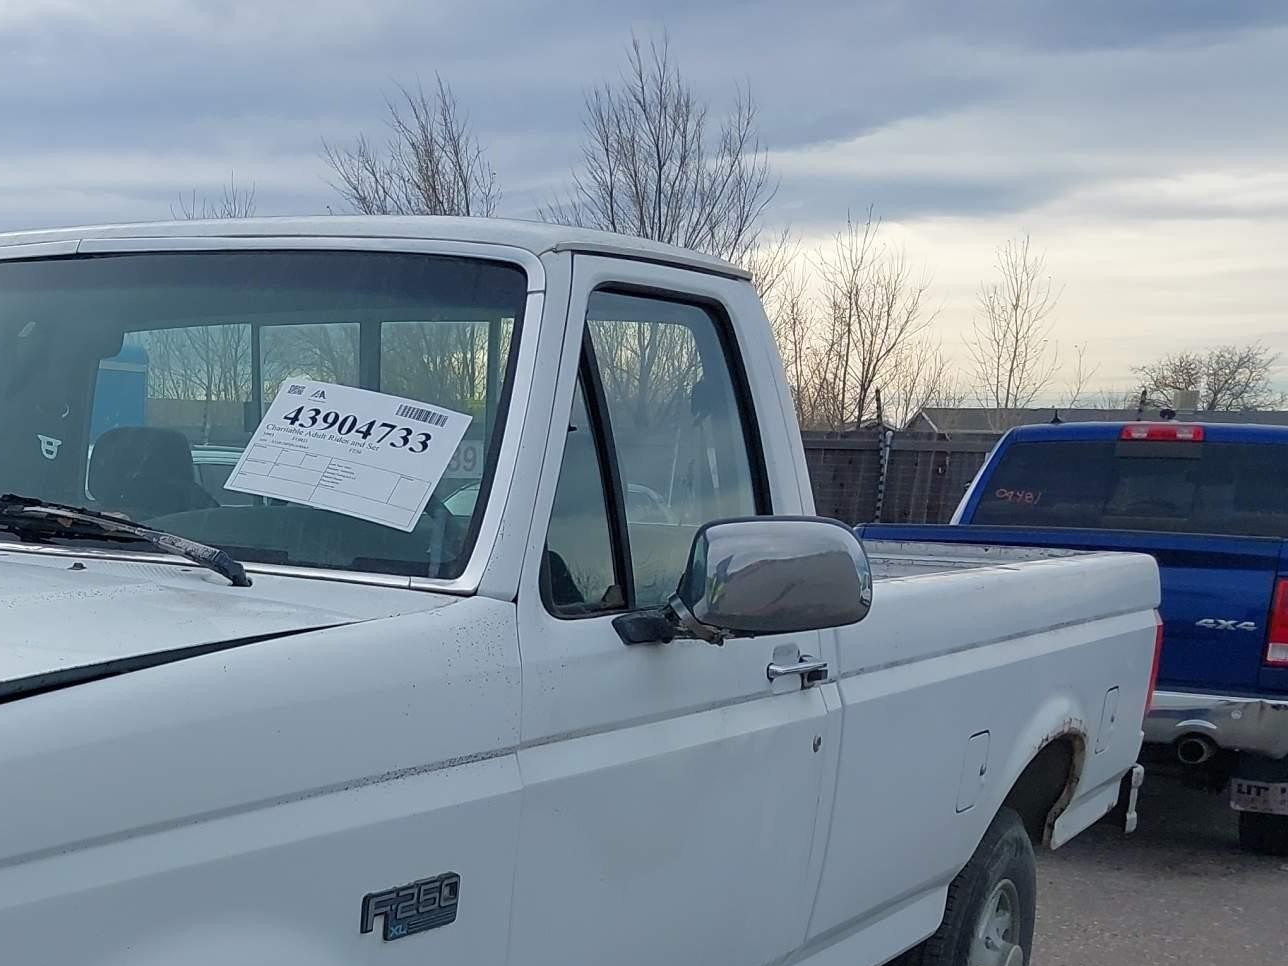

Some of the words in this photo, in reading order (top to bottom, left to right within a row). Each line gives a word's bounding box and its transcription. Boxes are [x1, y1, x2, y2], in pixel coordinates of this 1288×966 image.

[265, 423, 305, 436] Charitable
[304, 430, 328, 441] Adult
[327, 434, 349, 445] Rides
[350, 440, 366, 448] and
[283, 405, 432, 453] 43904733
